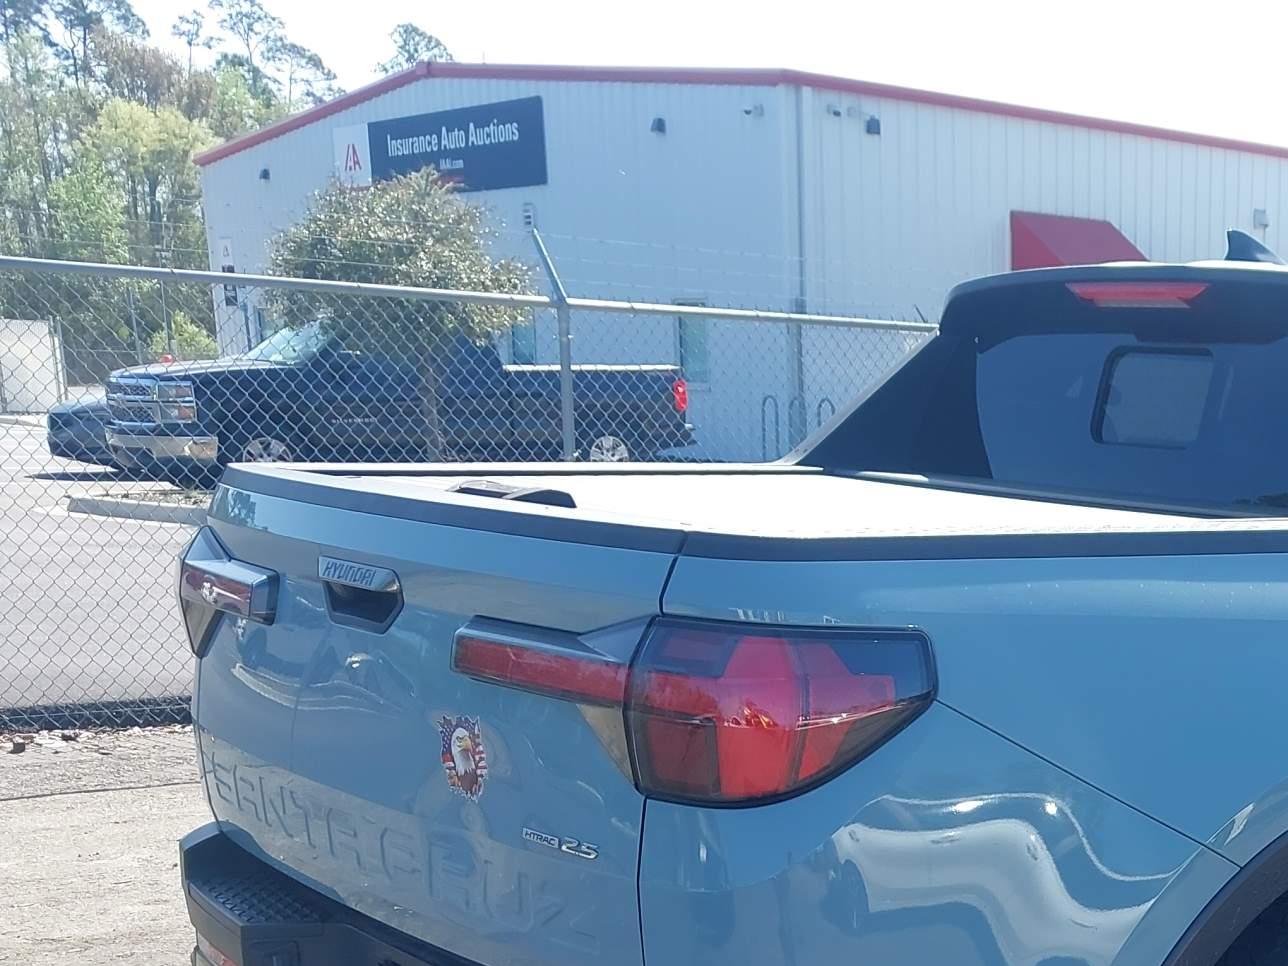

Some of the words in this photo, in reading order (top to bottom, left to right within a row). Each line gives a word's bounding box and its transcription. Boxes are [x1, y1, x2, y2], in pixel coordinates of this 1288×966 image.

[386, 134, 439, 157] Insurance
[441, 126, 466, 151] Auto
[468, 118, 520, 147] Auctions
[322, 561, 377, 587] HYUNDAI
[524, 830, 557, 847] HTRAC
